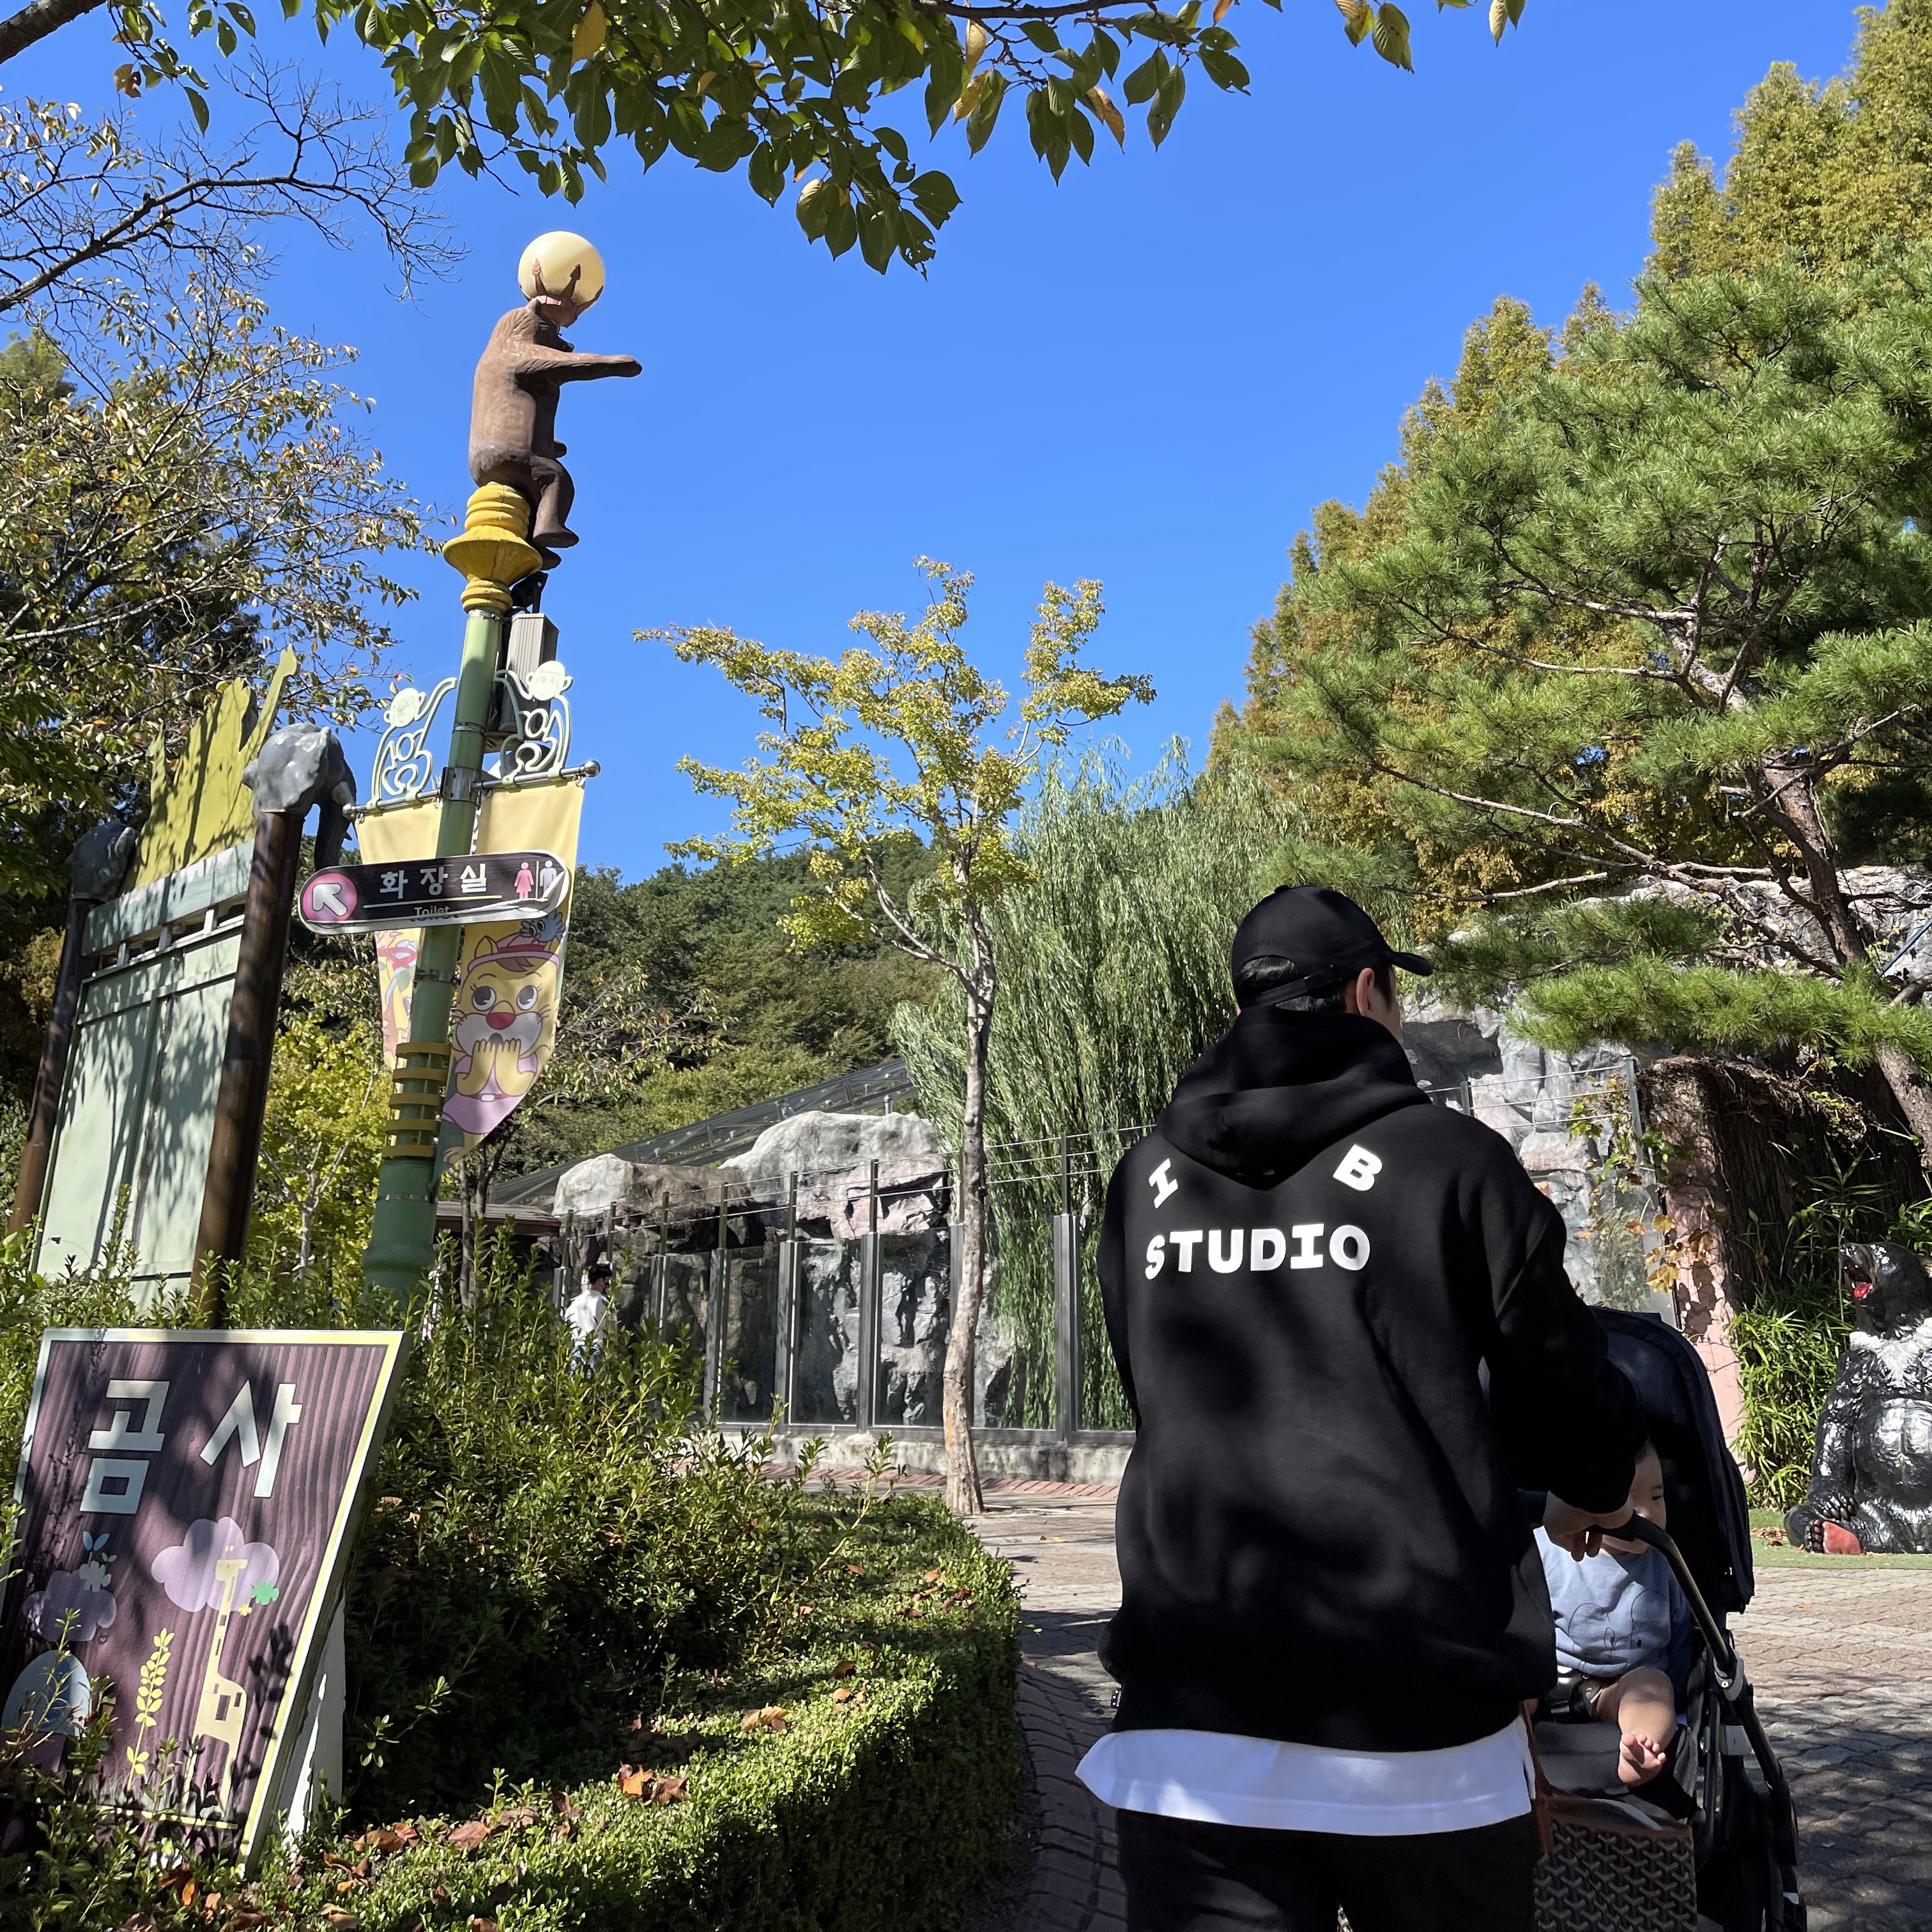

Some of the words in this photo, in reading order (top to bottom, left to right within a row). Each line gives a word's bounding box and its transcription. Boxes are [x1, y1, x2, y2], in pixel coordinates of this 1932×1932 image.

[379, 863, 487, 899] 화장실
[414, 905, 450, 916] Toilet
[1145, 1223, 1370, 1280] STUDIO
